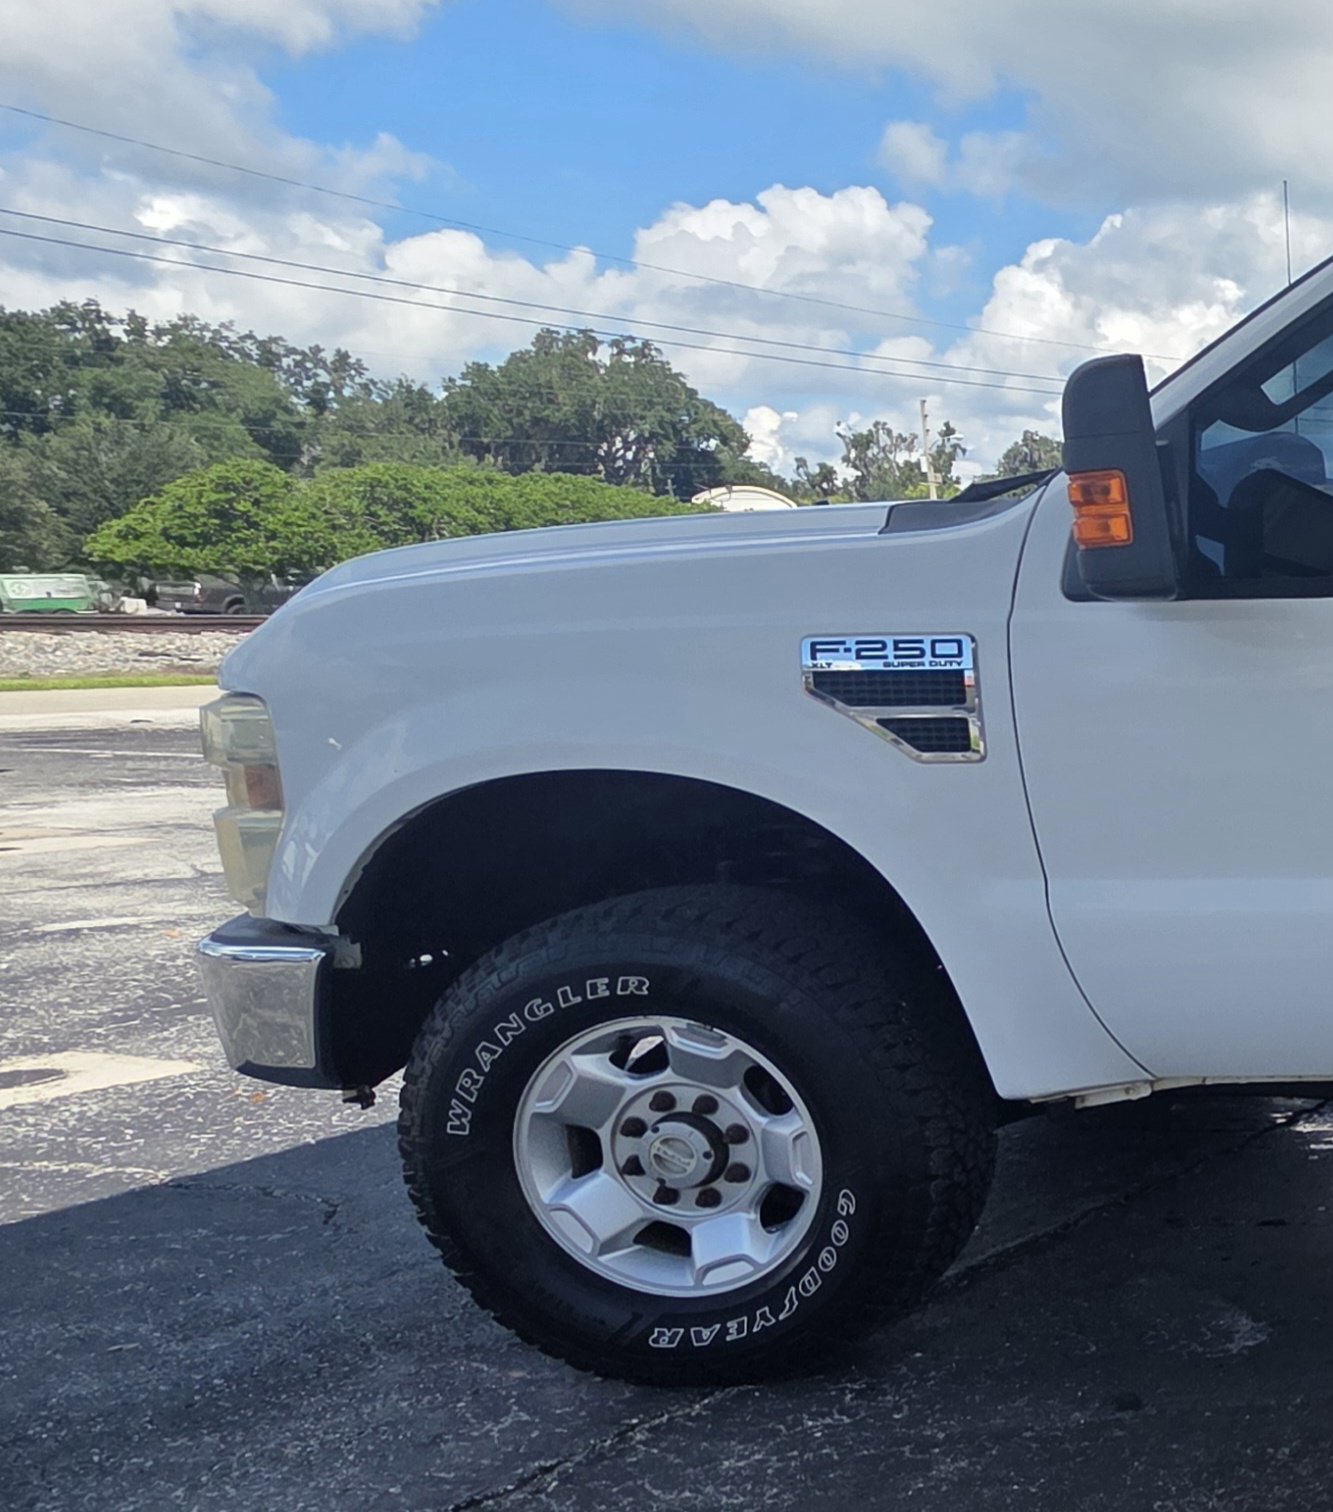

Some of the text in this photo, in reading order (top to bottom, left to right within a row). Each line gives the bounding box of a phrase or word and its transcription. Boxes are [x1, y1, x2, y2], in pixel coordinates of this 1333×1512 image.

[810, 638, 964, 661] F-250
[811, 662, 833, 670] XLT
[883, 660, 964, 668] SUPER DUTY
[447, 975, 649, 1136] WRANGLER
[648, 1188, 856, 1348] GOODYEAR
